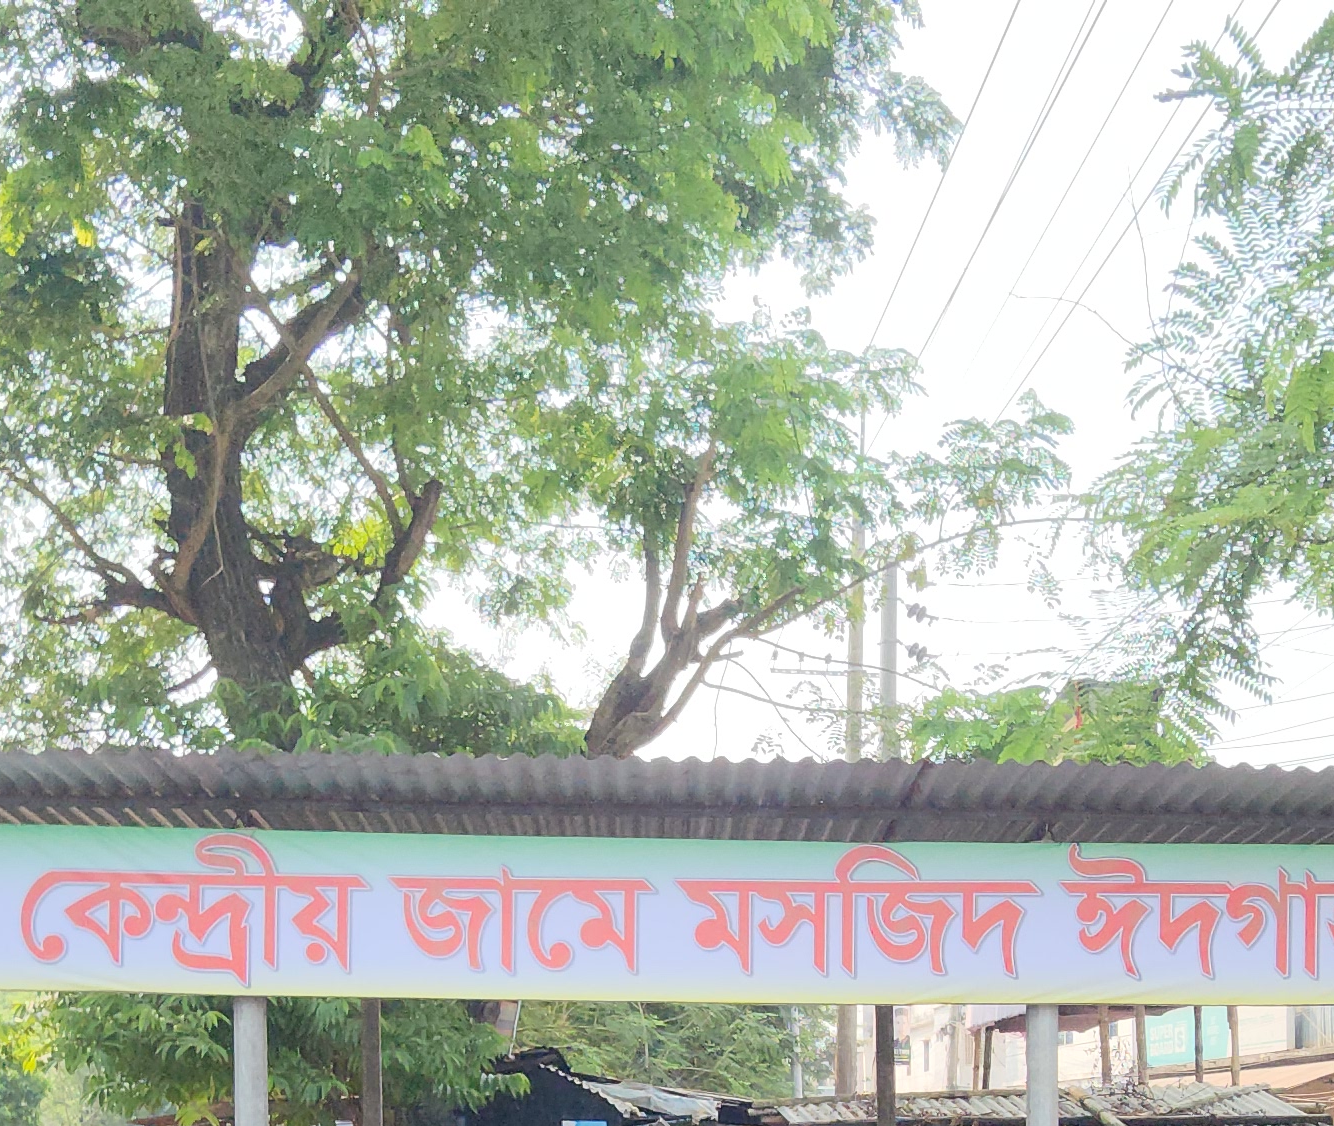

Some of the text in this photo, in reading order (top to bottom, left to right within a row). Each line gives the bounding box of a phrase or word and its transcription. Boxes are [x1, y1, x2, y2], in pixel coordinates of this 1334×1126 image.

[21, 833, 363, 988] কেন্দ্রীয়
[391, 865, 650, 975] জামে
[675, 846, 1039, 980] মসজিদ
